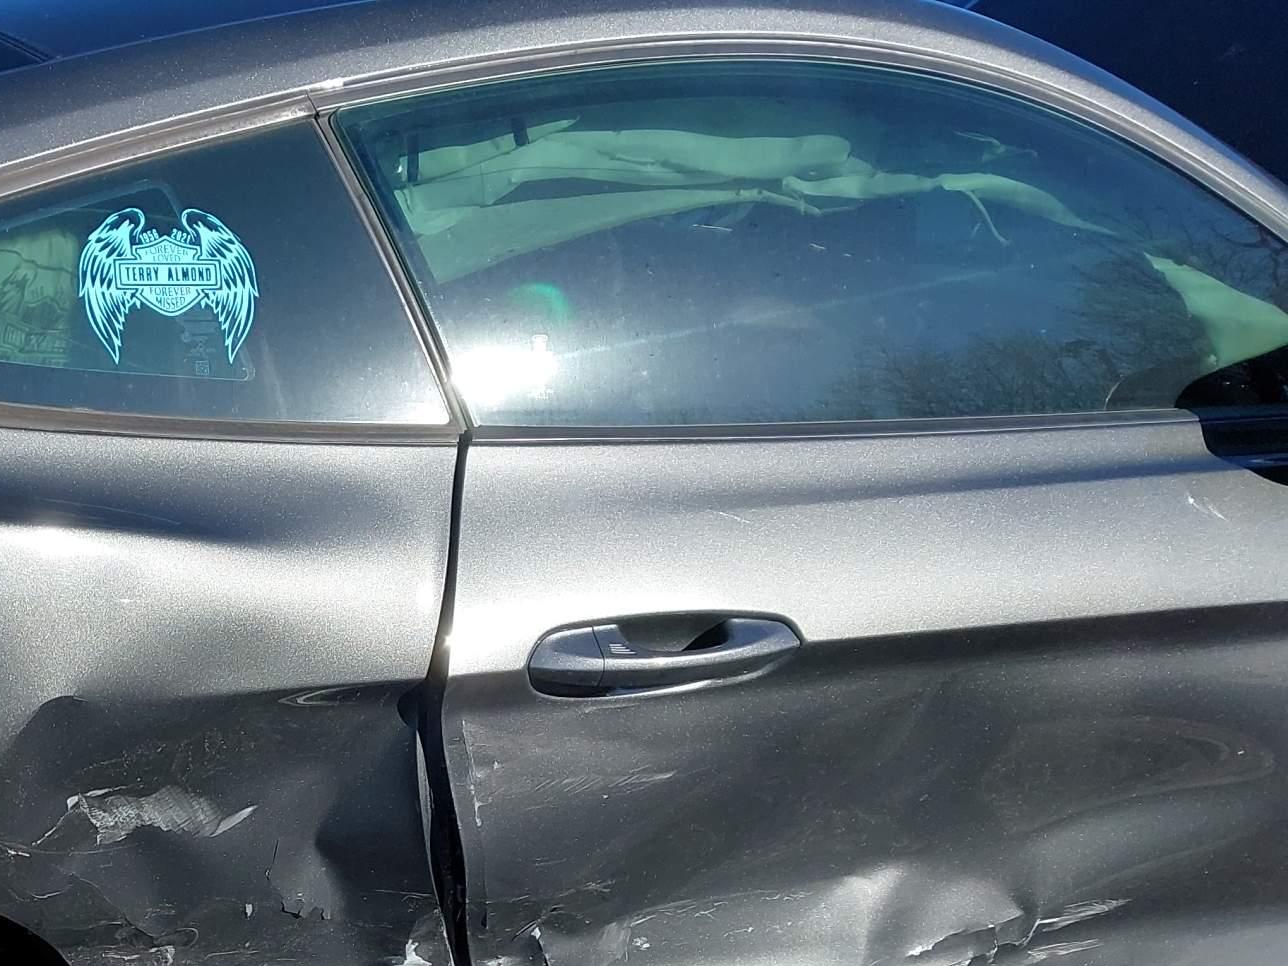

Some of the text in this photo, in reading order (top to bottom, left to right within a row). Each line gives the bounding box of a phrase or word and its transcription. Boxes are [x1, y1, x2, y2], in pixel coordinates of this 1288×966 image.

[145, 244, 189, 256] FOREVER
[124, 267, 212, 281] TERRY ALMOND
[149, 286, 192, 297] FOREVER
[155, 296, 186, 309] MISSED
